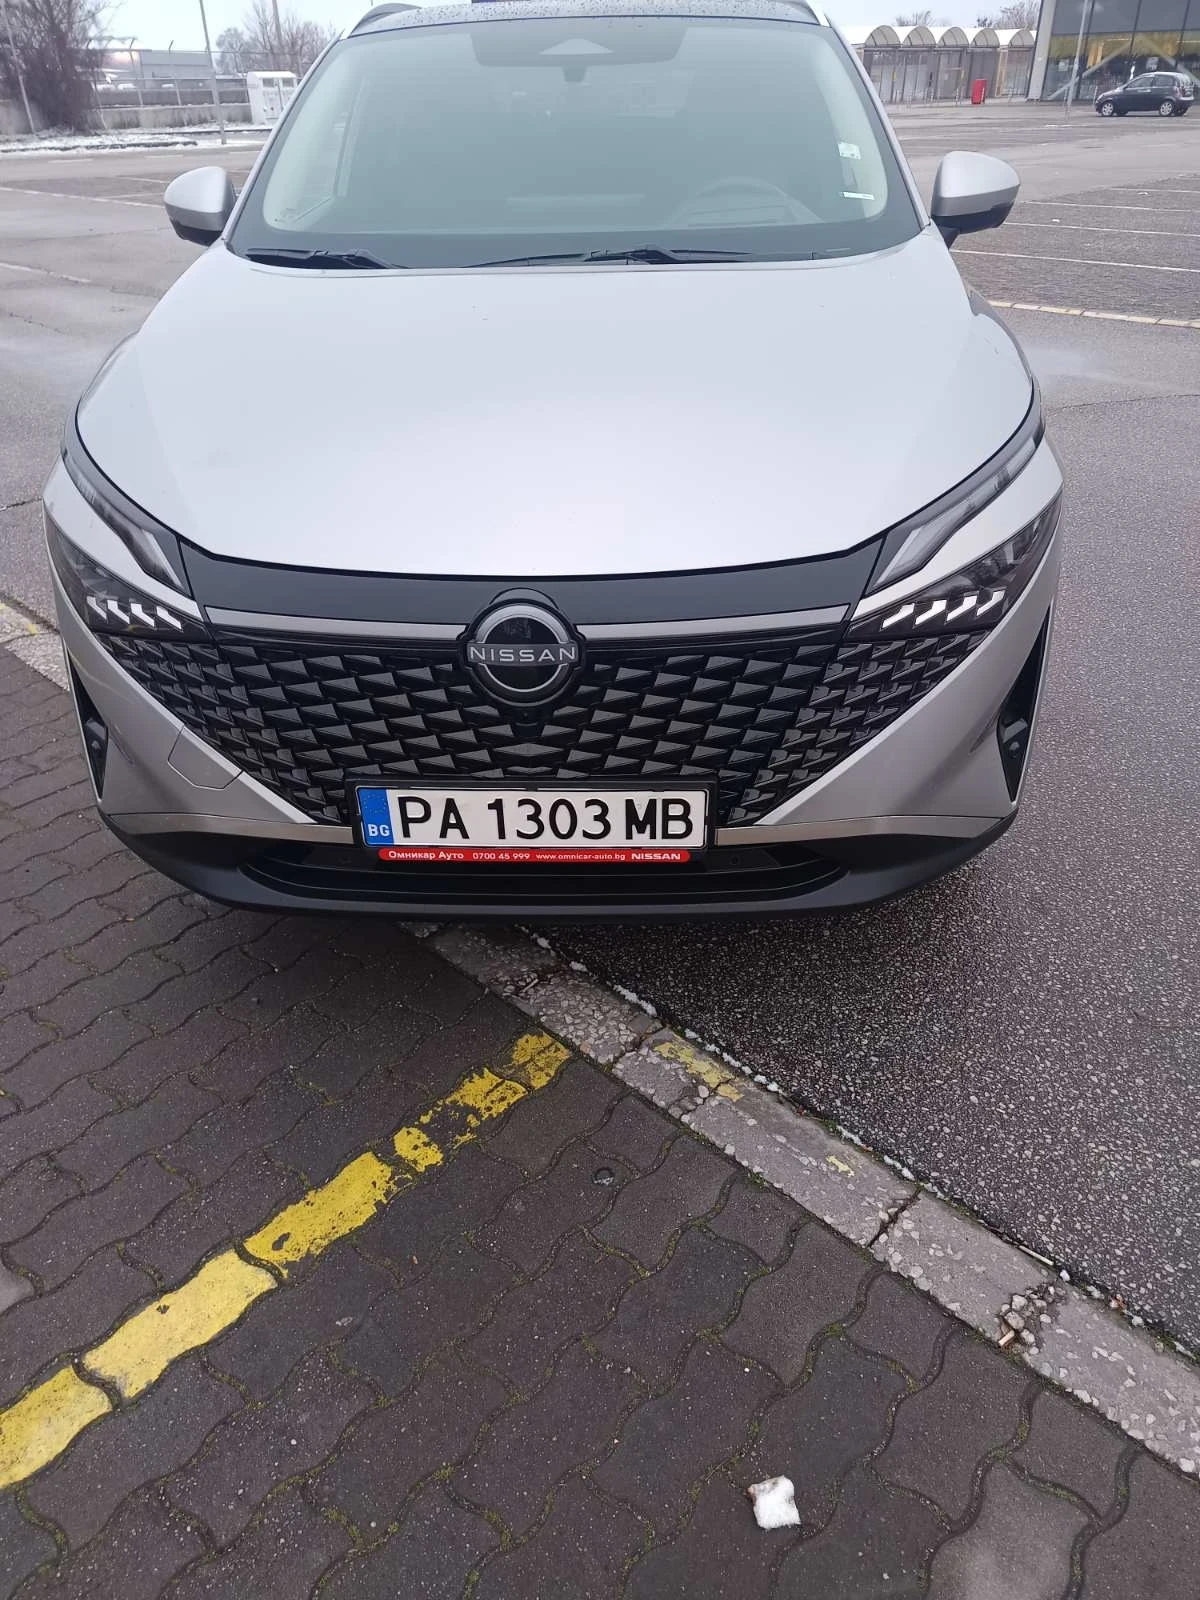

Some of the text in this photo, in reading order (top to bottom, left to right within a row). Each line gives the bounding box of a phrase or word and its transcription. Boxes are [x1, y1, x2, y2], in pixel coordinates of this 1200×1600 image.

[470, 646, 575, 662] NISSAN
[398, 796, 694, 840] PA 1303 MB
[367, 823, 390, 837] BG
[388, 850, 681, 861] Омникар Ауто 0700 45 999 www.omnicar-auto.bg NISSAN
